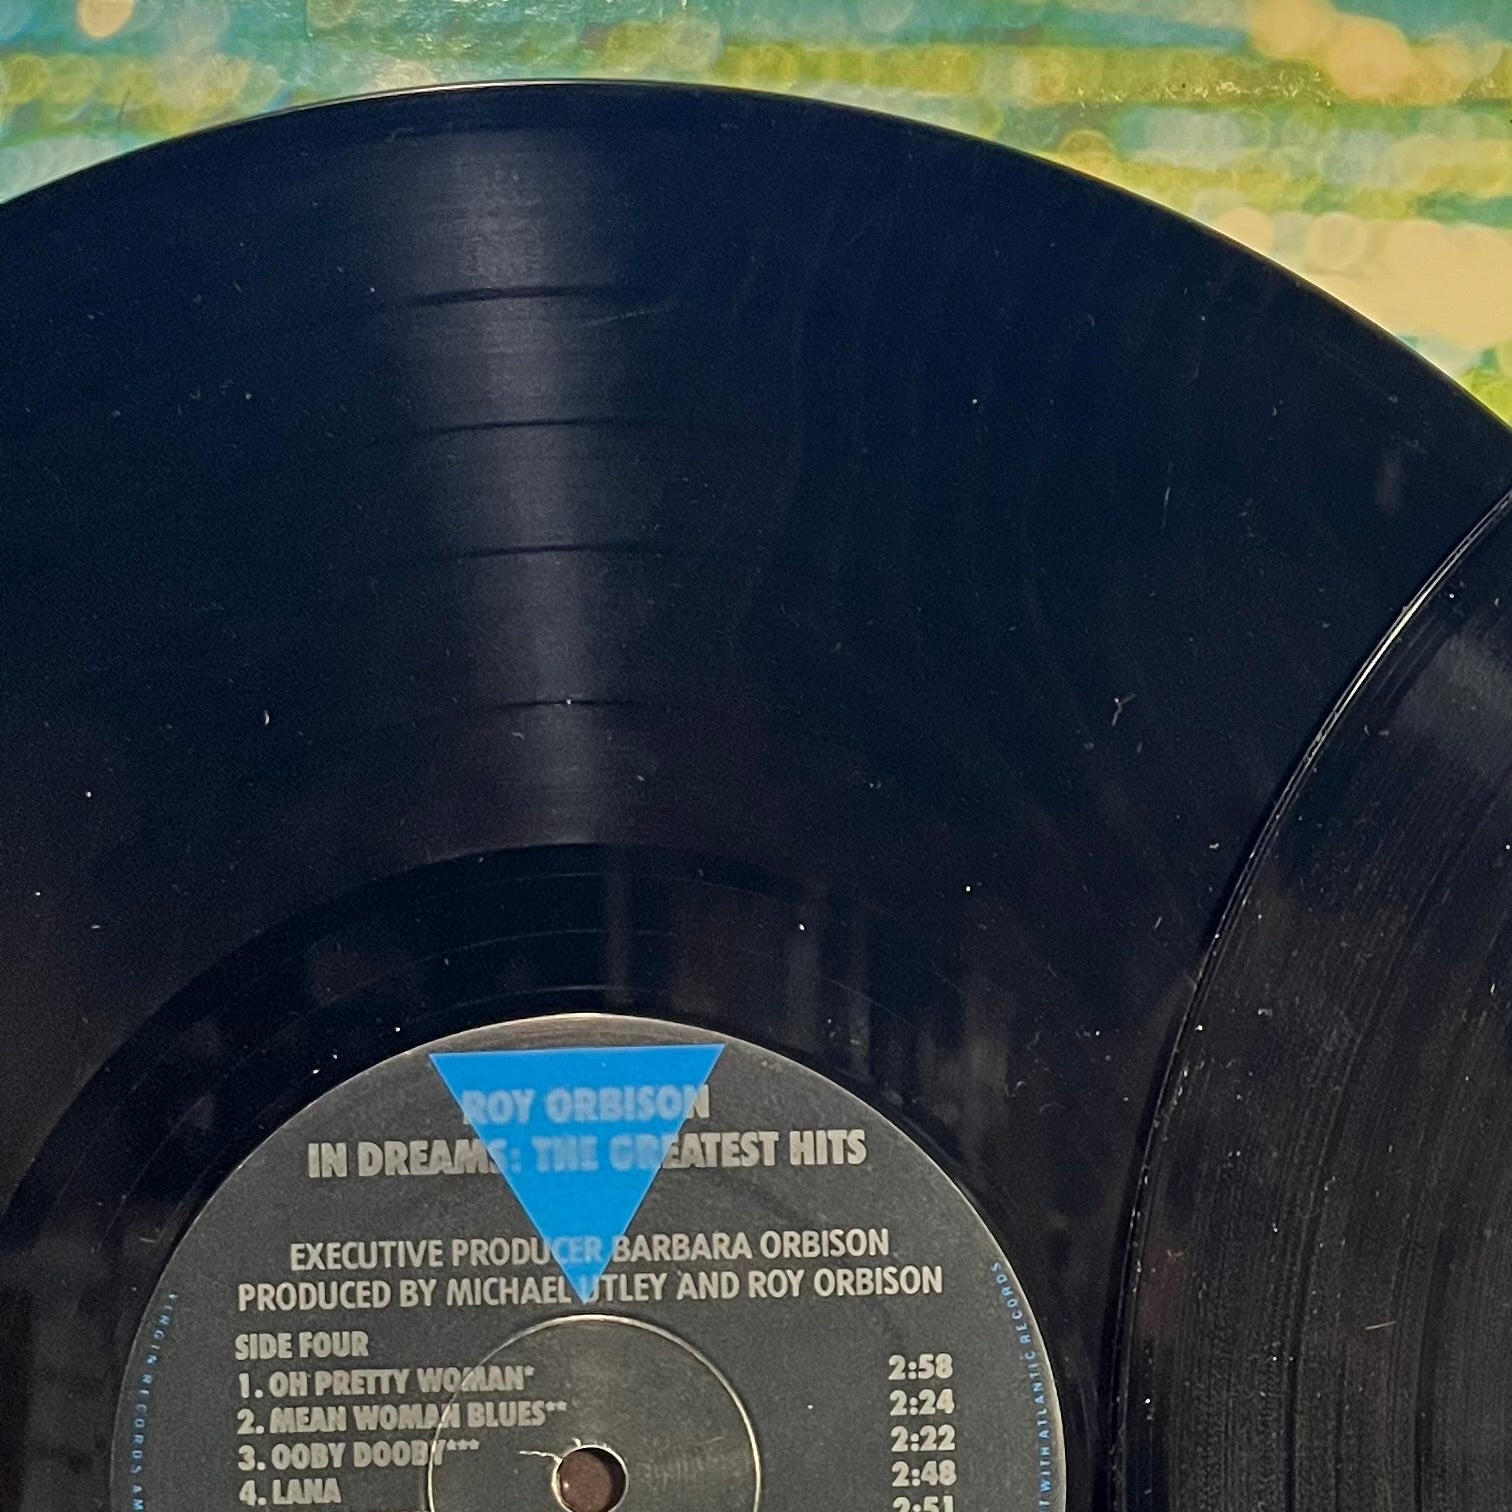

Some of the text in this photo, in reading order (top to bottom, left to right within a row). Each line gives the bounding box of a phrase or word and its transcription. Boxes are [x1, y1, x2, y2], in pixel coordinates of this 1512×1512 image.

[462, 1084, 711, 1125] ROY ORBISON
[308, 1129, 867, 1178] IN DREAMS: THE GREATEST HITS
[290, 1228, 889, 1271] EXECUTIVE PRODUCER BARBARA ORBISON
[238, 1265, 943, 1312] PRODUCED BY MICHAEL UTLEY AND ROY ORBISON
[235, 1331, 369, 1361] SIDE FOUR
[888, 1353, 953, 1381] 2:58
[238, 1372, 264, 1398] 1.
[269, 1371, 308, 1397] OH
[315, 1368, 410, 1396] PRETTY
[890, 1388, 955, 1416] 2:24
[237, 1408, 265, 1435] 2.
[270, 1405, 347, 1434] MEAN
[353, 1402, 461, 1431] WOMAN
[891, 1424, 956, 1452] 2:22
[238, 1445, 265, 1471] 3.
[271, 1442, 345, 1470] OOBY
[892, 1459, 957, 1487] 2:48
[238, 1478, 342, 1506] 4. LANA
